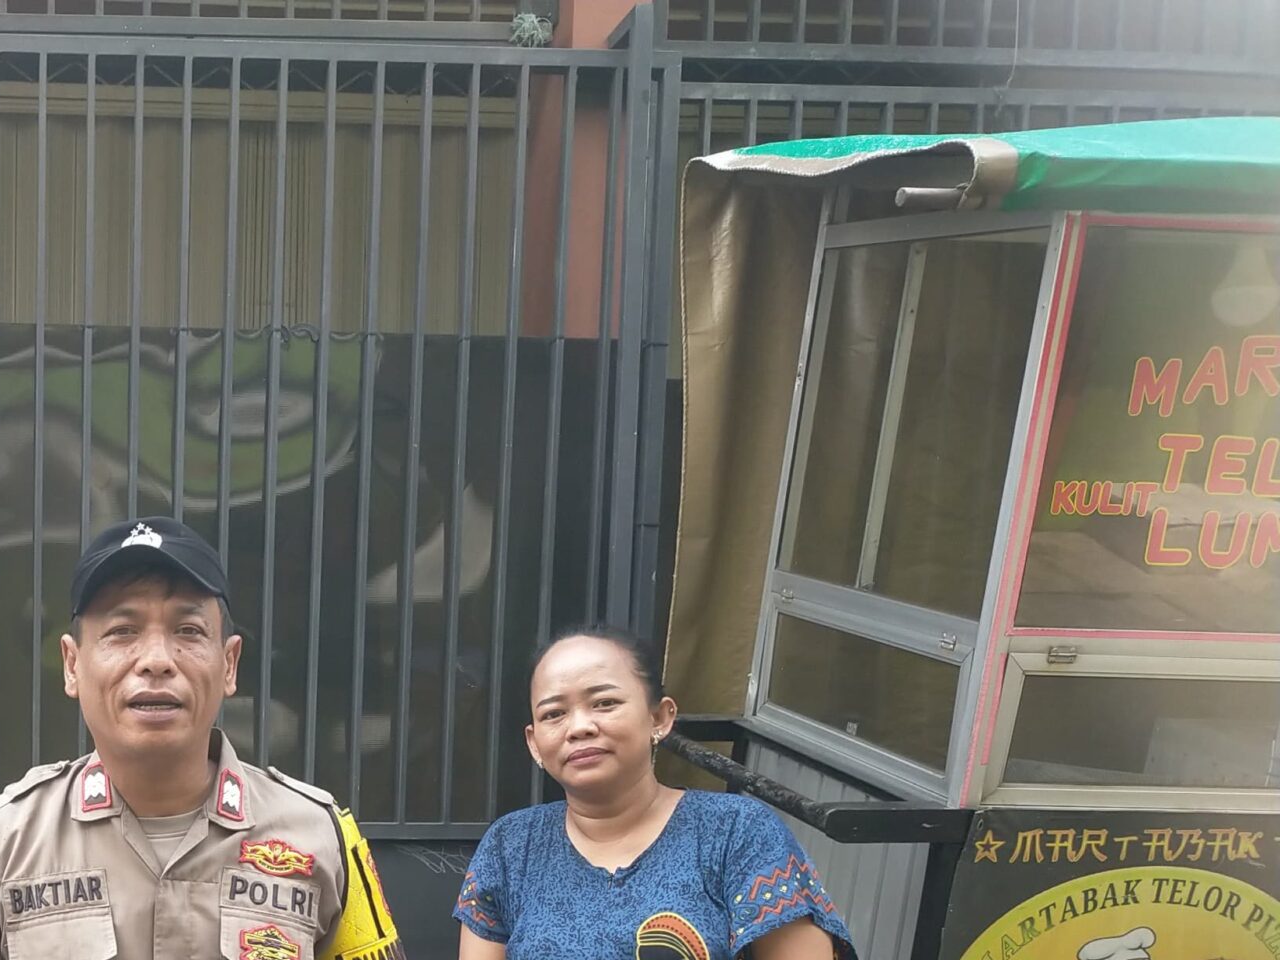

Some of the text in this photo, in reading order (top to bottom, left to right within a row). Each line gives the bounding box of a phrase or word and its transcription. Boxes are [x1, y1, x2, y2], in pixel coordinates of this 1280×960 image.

[1050, 480, 1159, 517] KULIT
[9, 874, 104, 915] BAKTIAR
[228, 874, 314, 918] POLRI
[1152, 878, 1242, 920] TELOR
